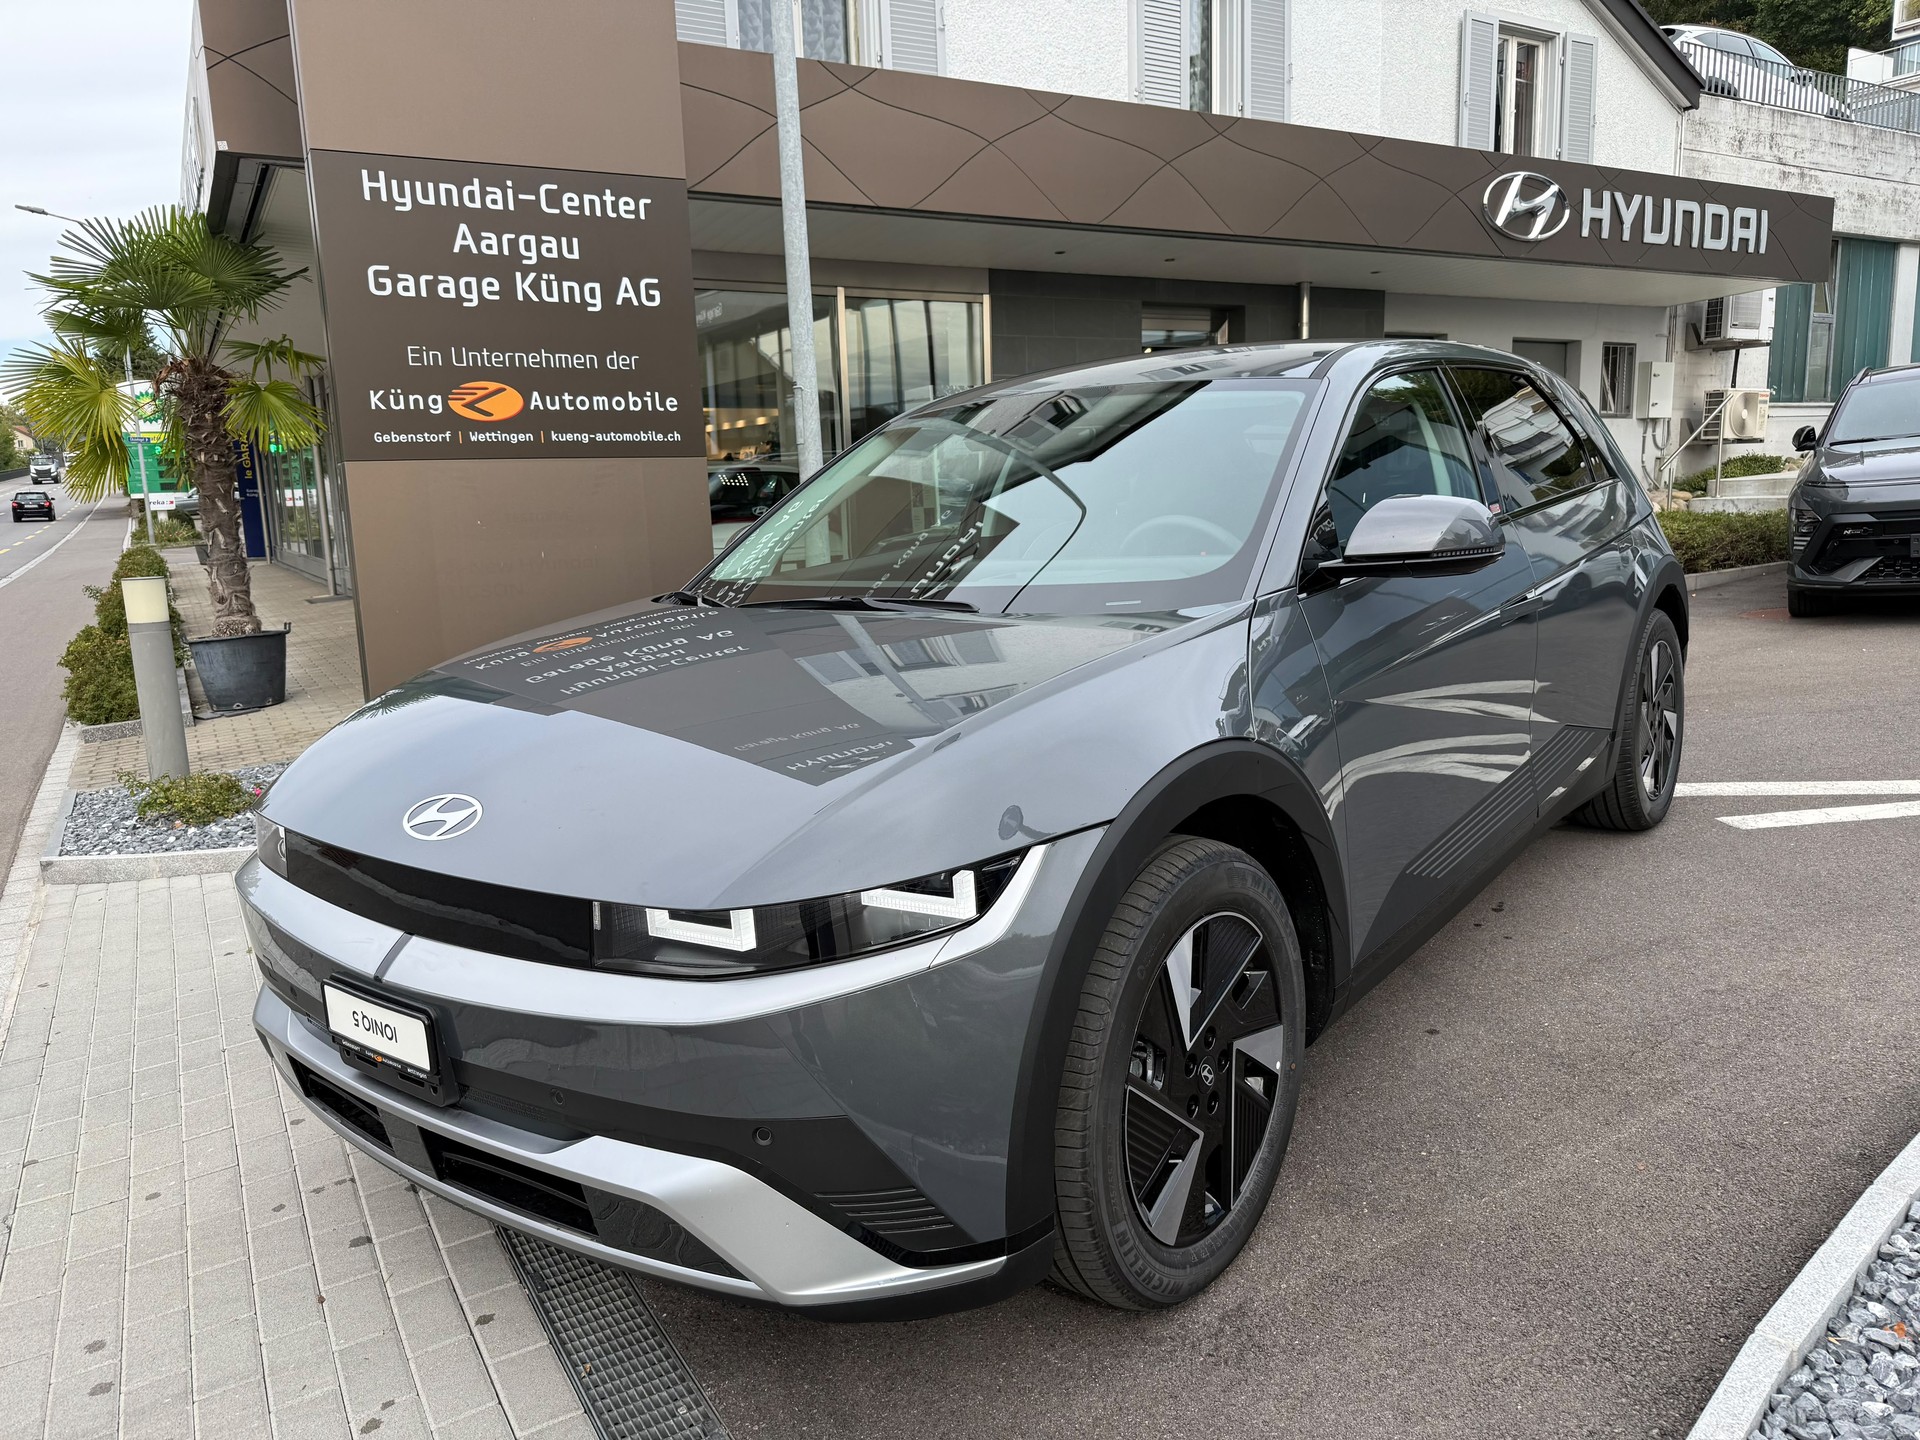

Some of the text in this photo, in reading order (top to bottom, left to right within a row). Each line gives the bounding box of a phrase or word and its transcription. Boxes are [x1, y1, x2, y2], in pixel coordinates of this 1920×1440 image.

[360, 169, 652, 220] Hyundai-Center
[1580, 188, 1768, 254] HYUNDAI
[453, 223, 580, 264] Aargau
[366, 264, 662, 312] Garage Küng AG
[407, 345, 640, 370] Ein Unternehmen der
[369, 389, 678, 414] Küng Automobile
[240, 431, 252, 468] GARA
[374, 430, 682, 444] Gebenstorf Wettingen kueng-automobile.ch
[352, 1010, 398, 1043] IONIQ 5
